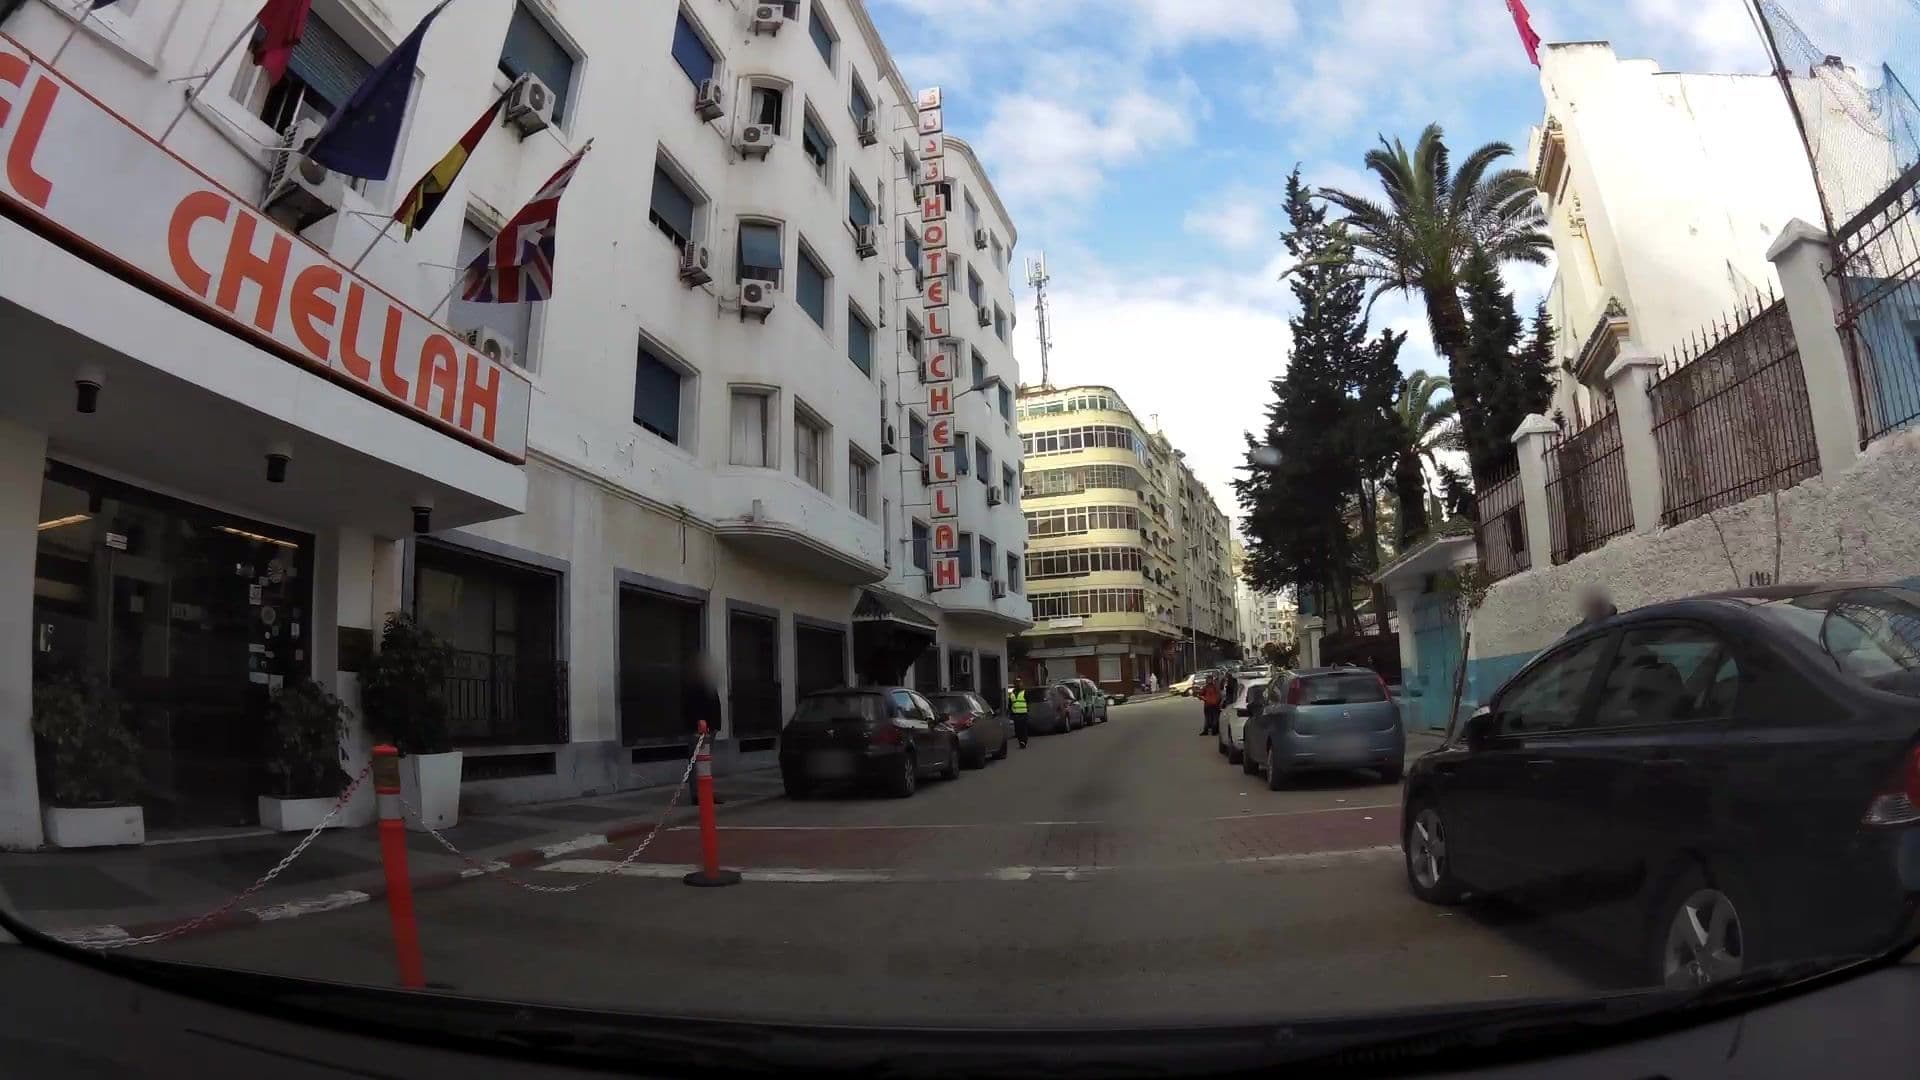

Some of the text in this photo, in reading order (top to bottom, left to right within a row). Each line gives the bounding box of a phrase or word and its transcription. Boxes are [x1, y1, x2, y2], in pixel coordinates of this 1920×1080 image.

[168, 190, 500, 443] CHELLAH
[924, 200, 955, 586] HOTEL CHELLAH
